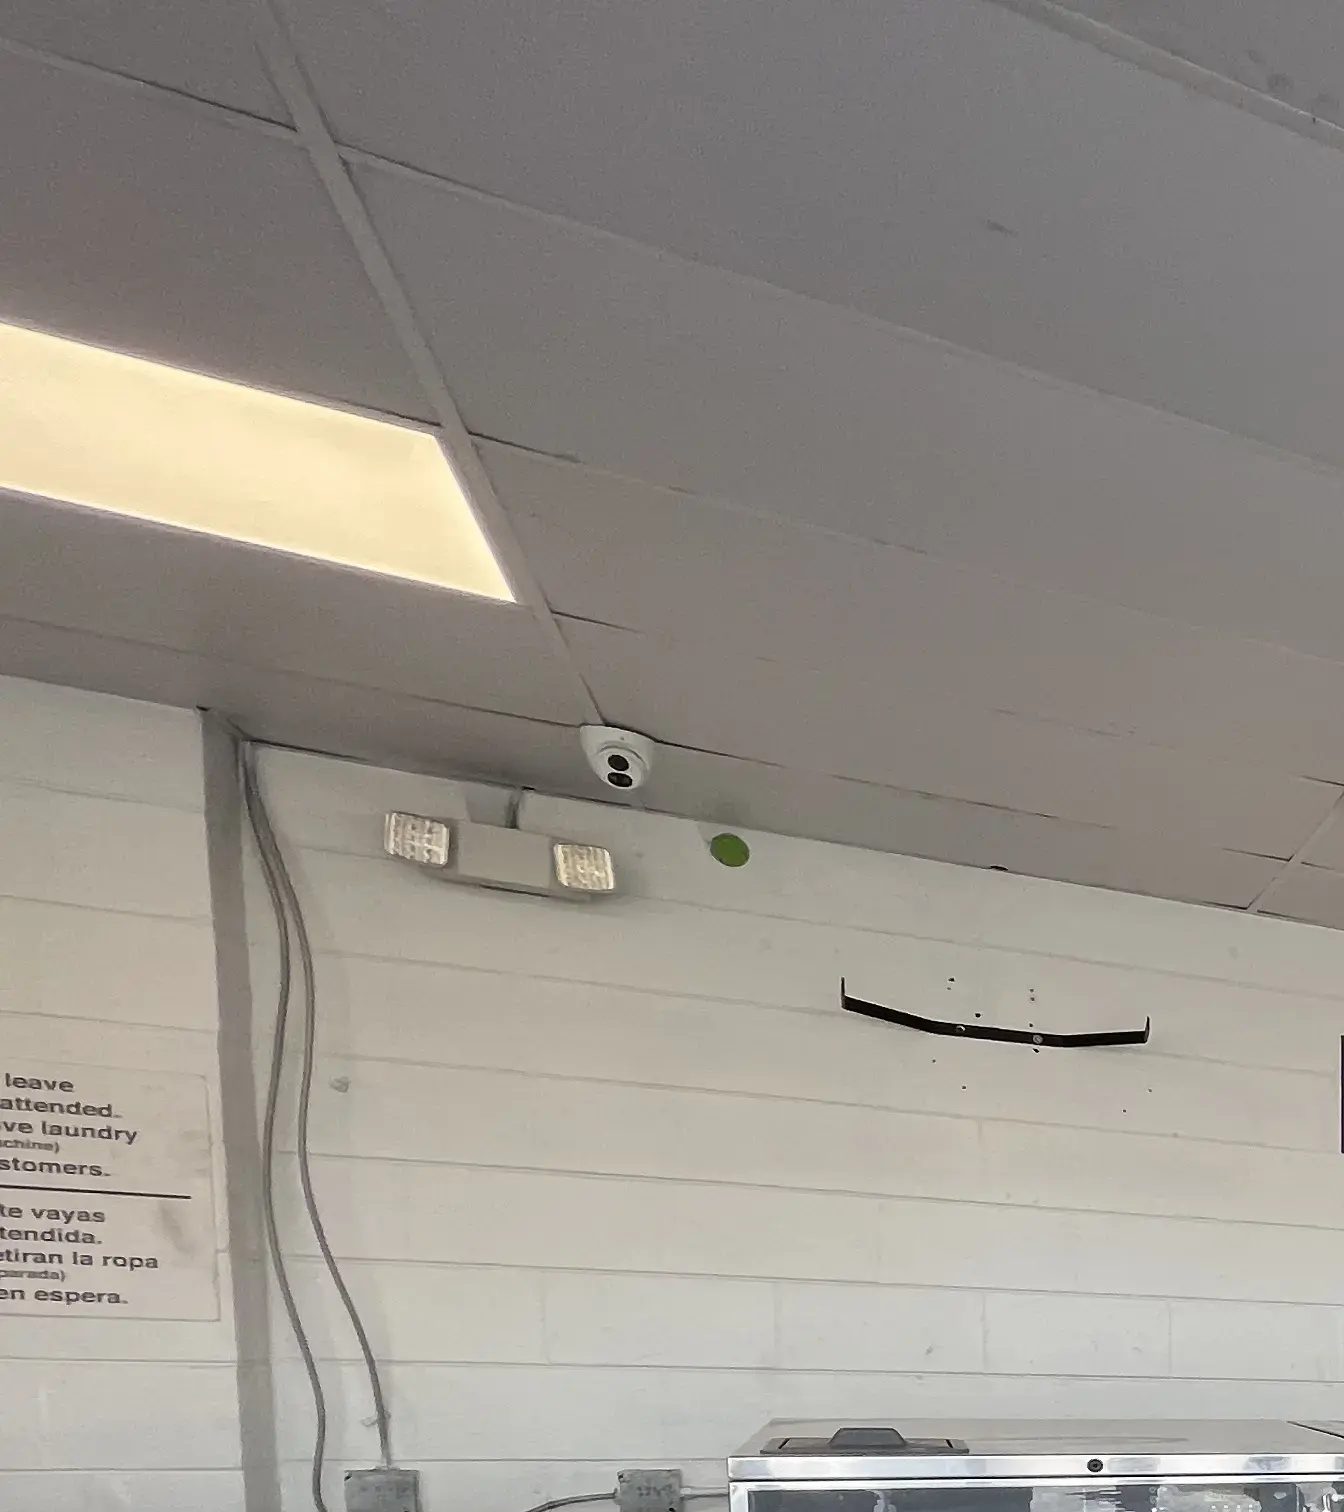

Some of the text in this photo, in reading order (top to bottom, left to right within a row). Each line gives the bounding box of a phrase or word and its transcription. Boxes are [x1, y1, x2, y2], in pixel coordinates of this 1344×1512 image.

[5, 1072, 75, 1092] leave
[0, 1120, 138, 1145] ve laundry
[31, 1208, 105, 1224] vayas
[72, 1251, 93, 1266] la
[102, 1255, 159, 1271] ropa
[34, 1288, 128, 1305] espera.
